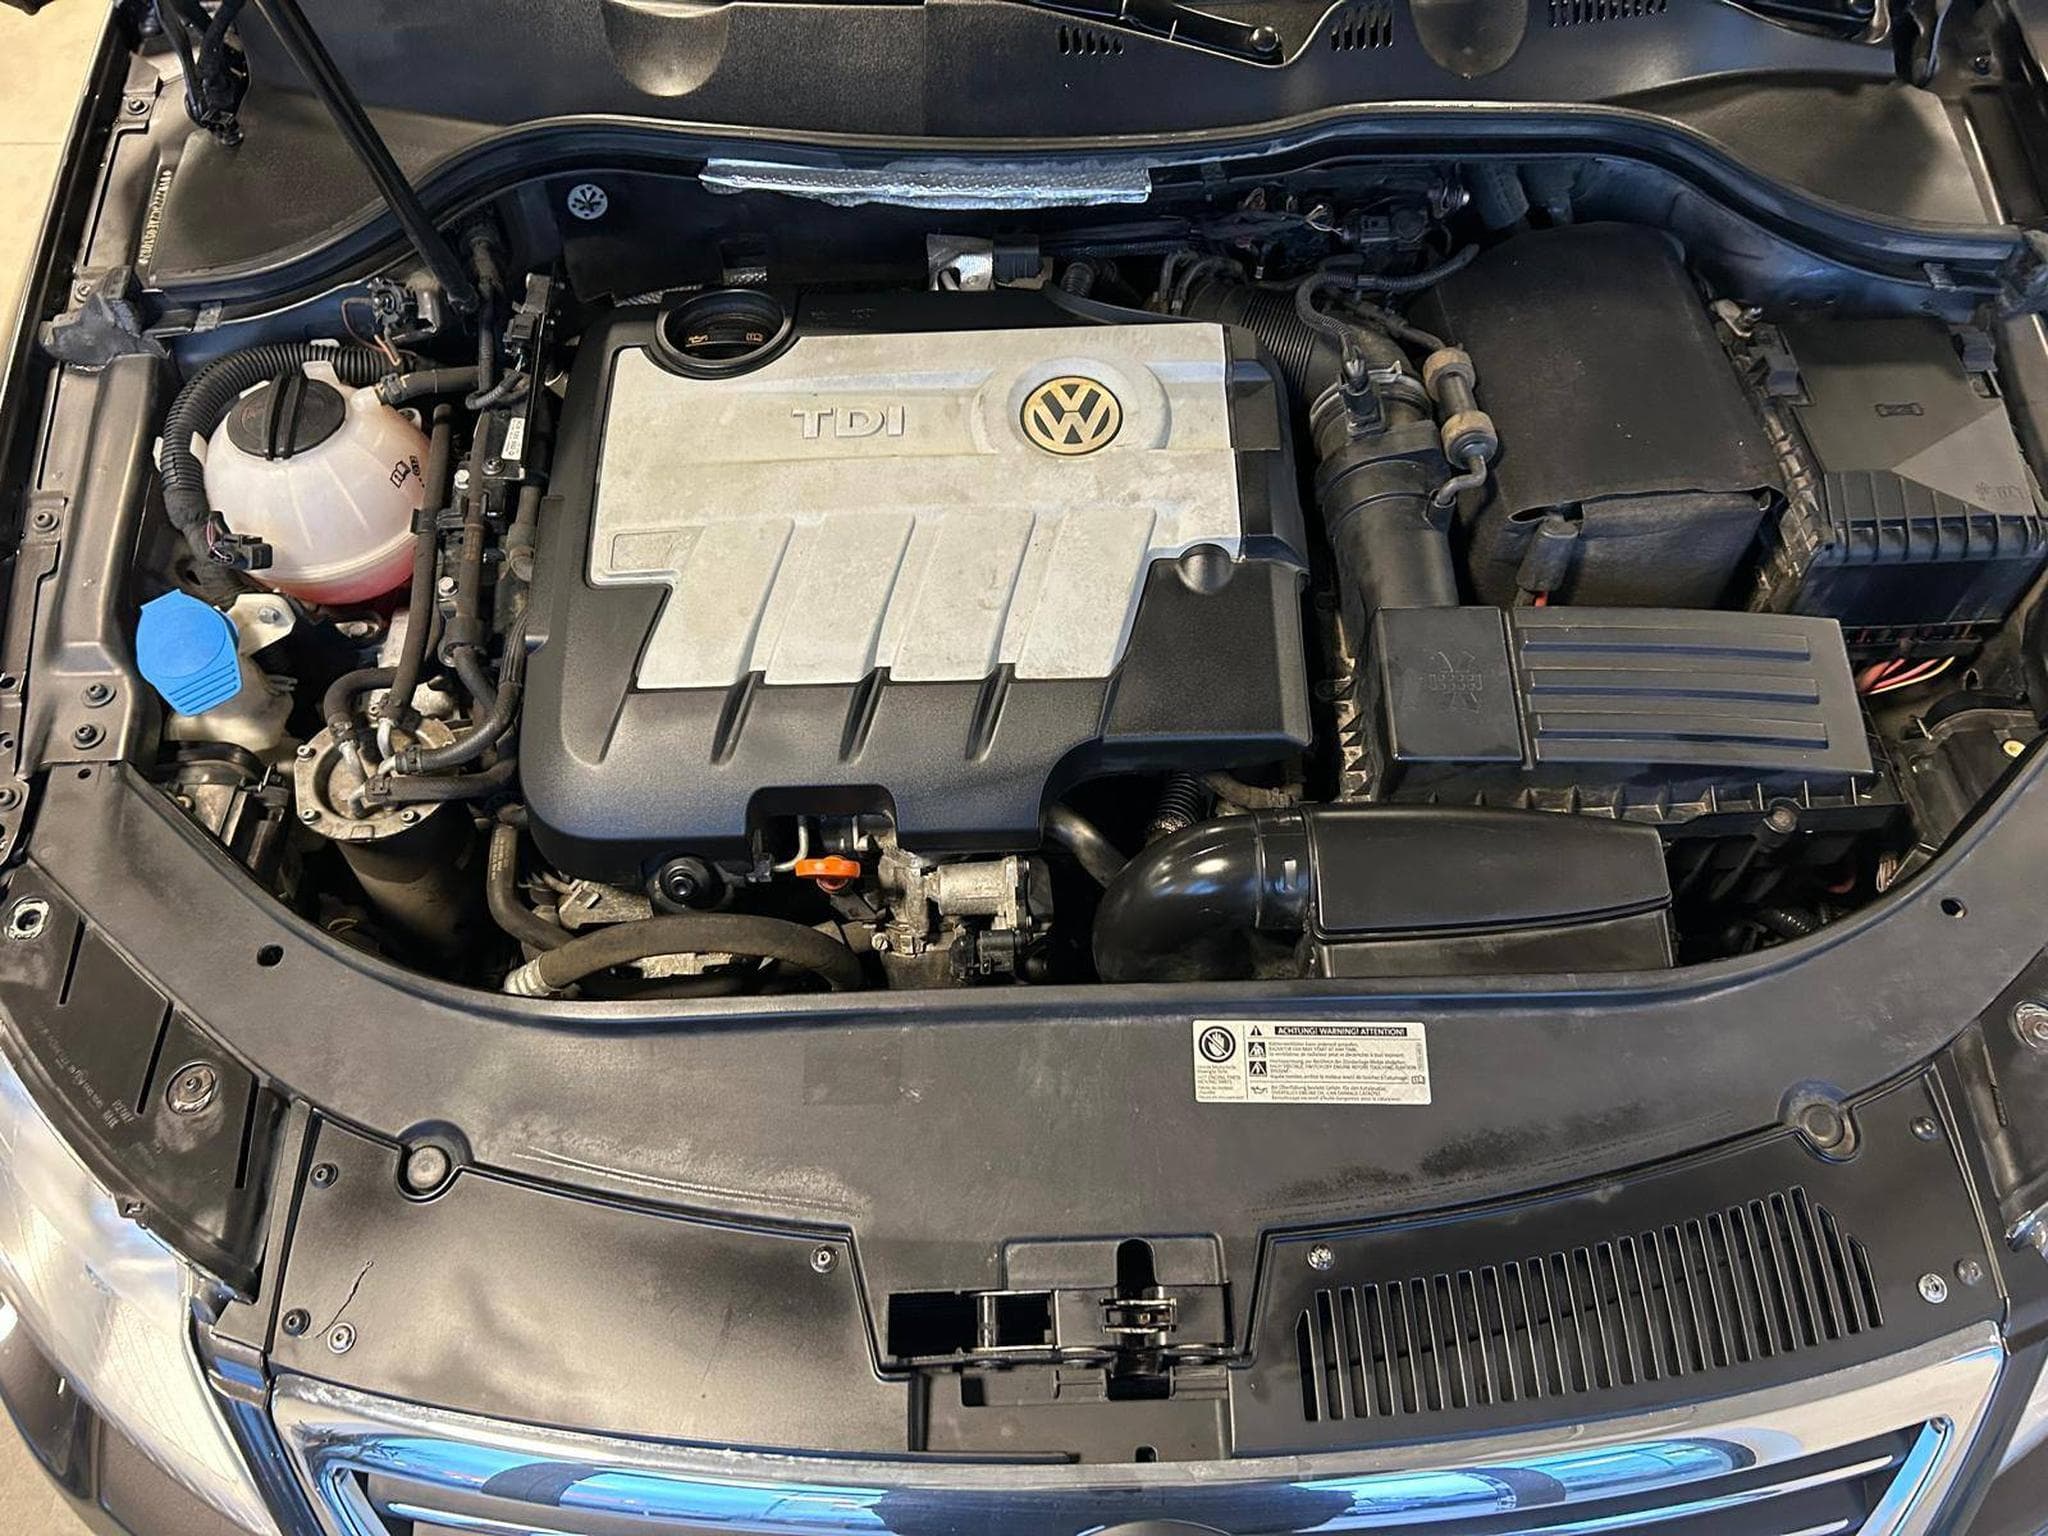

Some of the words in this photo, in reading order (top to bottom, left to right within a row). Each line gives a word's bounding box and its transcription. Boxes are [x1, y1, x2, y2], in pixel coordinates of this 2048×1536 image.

[791, 405, 905, 439] TDI
[1278, 1027, 1318, 1035] ACHTUNG!
[1320, 1027, 1360, 1035] WARNING!
[1361, 1028, 1405, 1036] ATTENTION!
